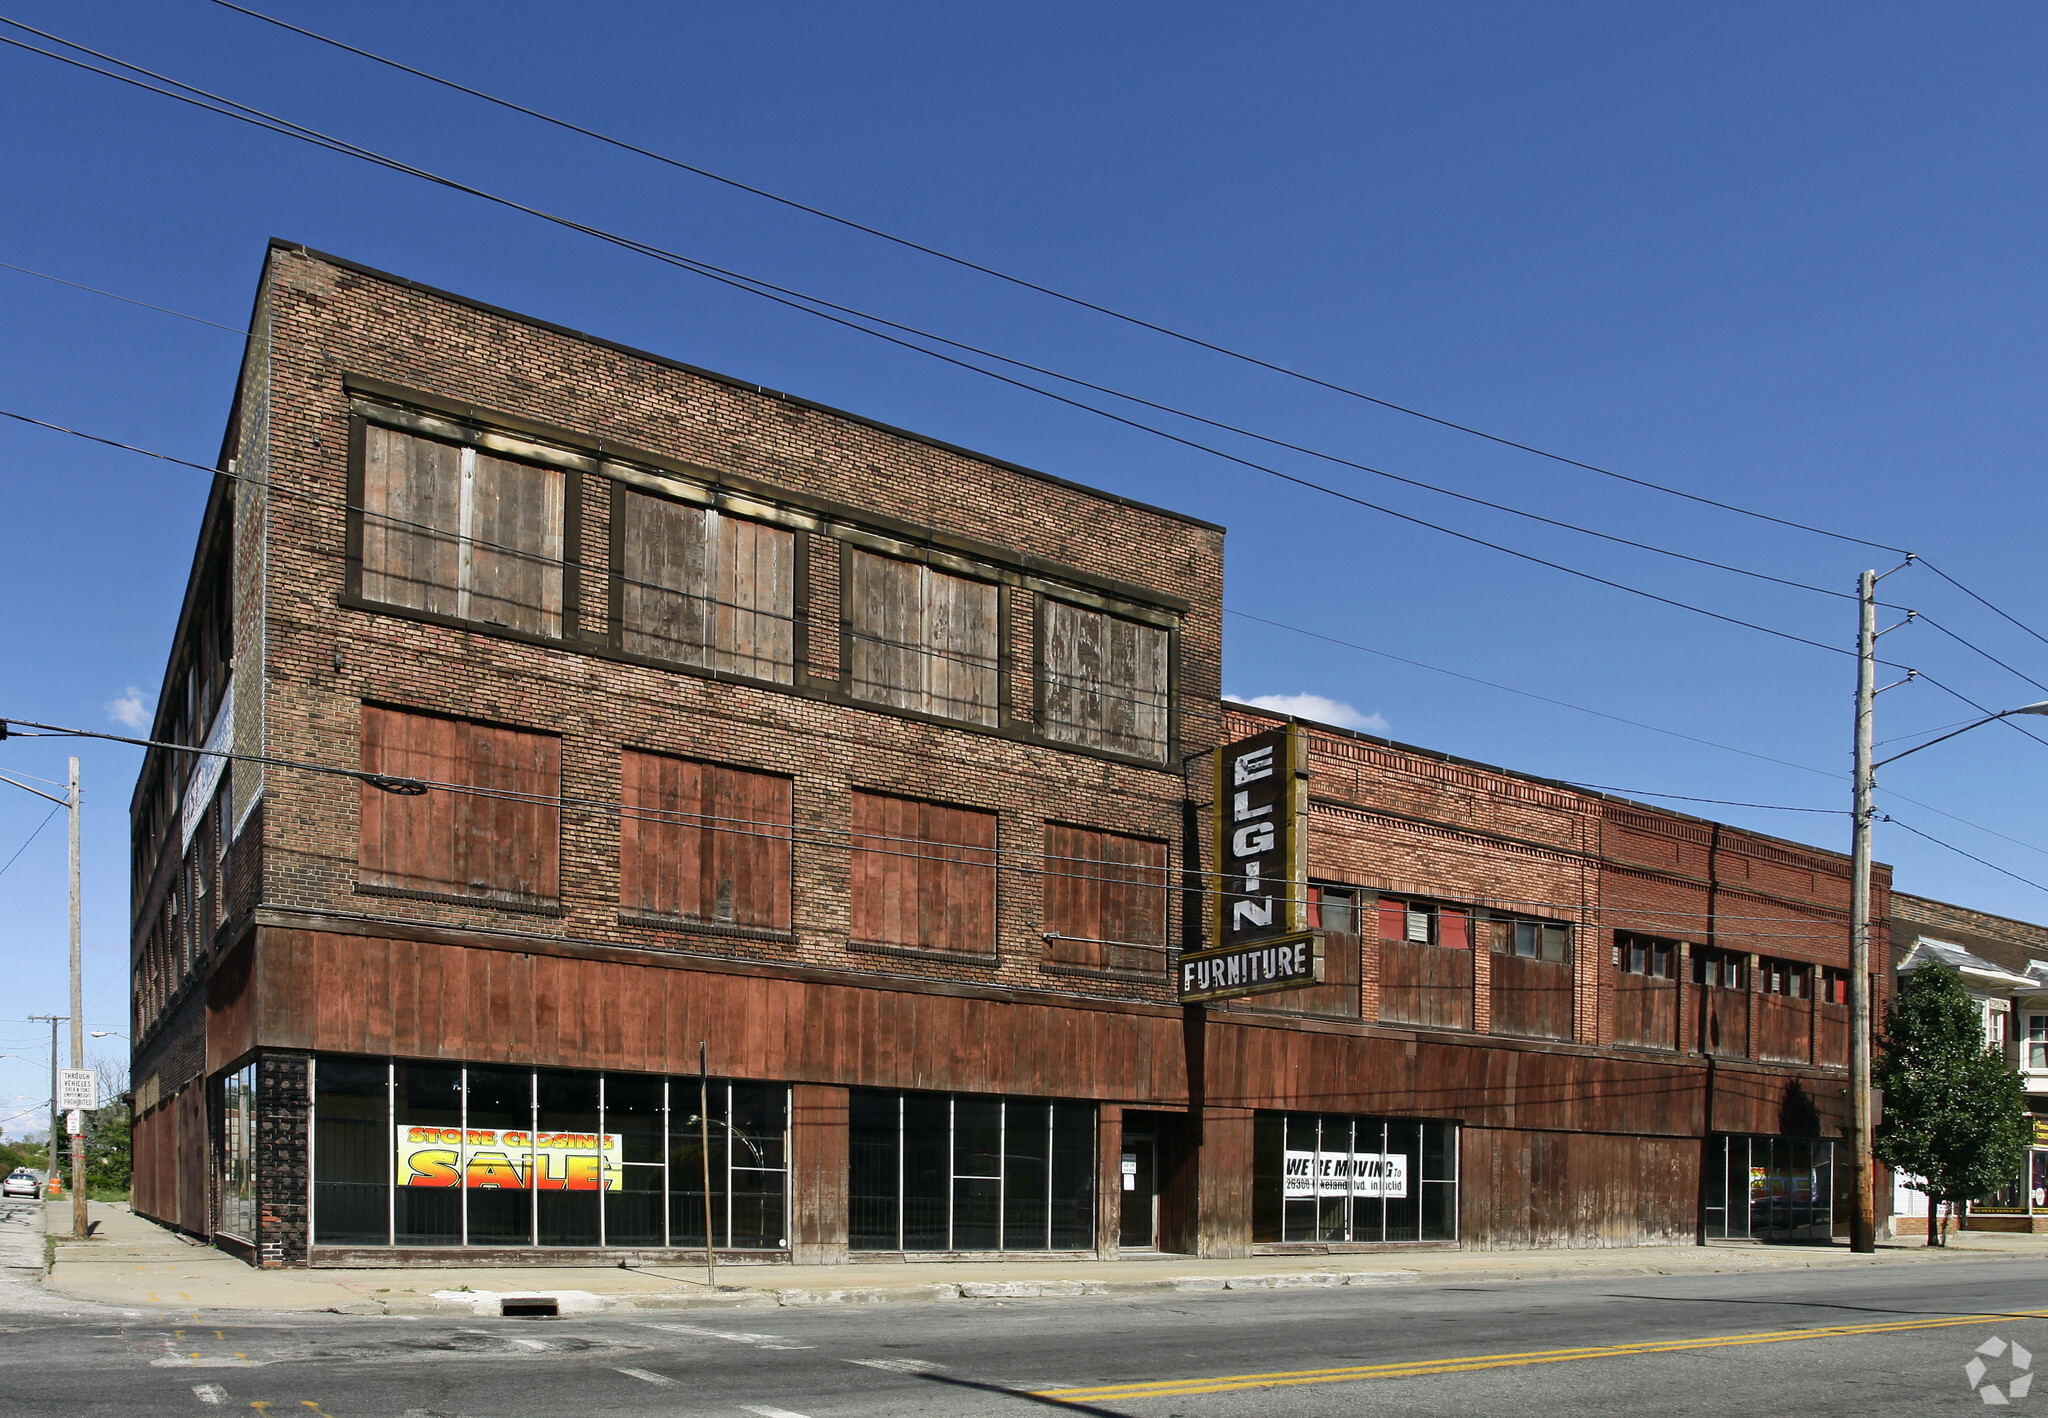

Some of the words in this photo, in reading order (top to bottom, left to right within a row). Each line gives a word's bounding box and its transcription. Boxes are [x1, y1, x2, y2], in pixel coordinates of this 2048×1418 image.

[1232, 745, 1275, 932] ELGIN
[1183, 942, 1306, 992] FURNITURE
[64, 1072, 90, 1080] THROUGH
[64, 1098, 92, 1106] PROHIBITED
[407, 1127, 497, 1147] STORE
[502, 1131, 615, 1150] CLOSING
[407, 1148, 615, 1191] SALE
[1286, 1158, 1332, 1176] WE'RE
[1334, 1160, 1394, 1178] MOVING
[1312, 1180, 1348, 1190] Lkeland
[1348, 1180, 1367, 1190] lvd.
[1370, 1180, 1378, 1191] in
